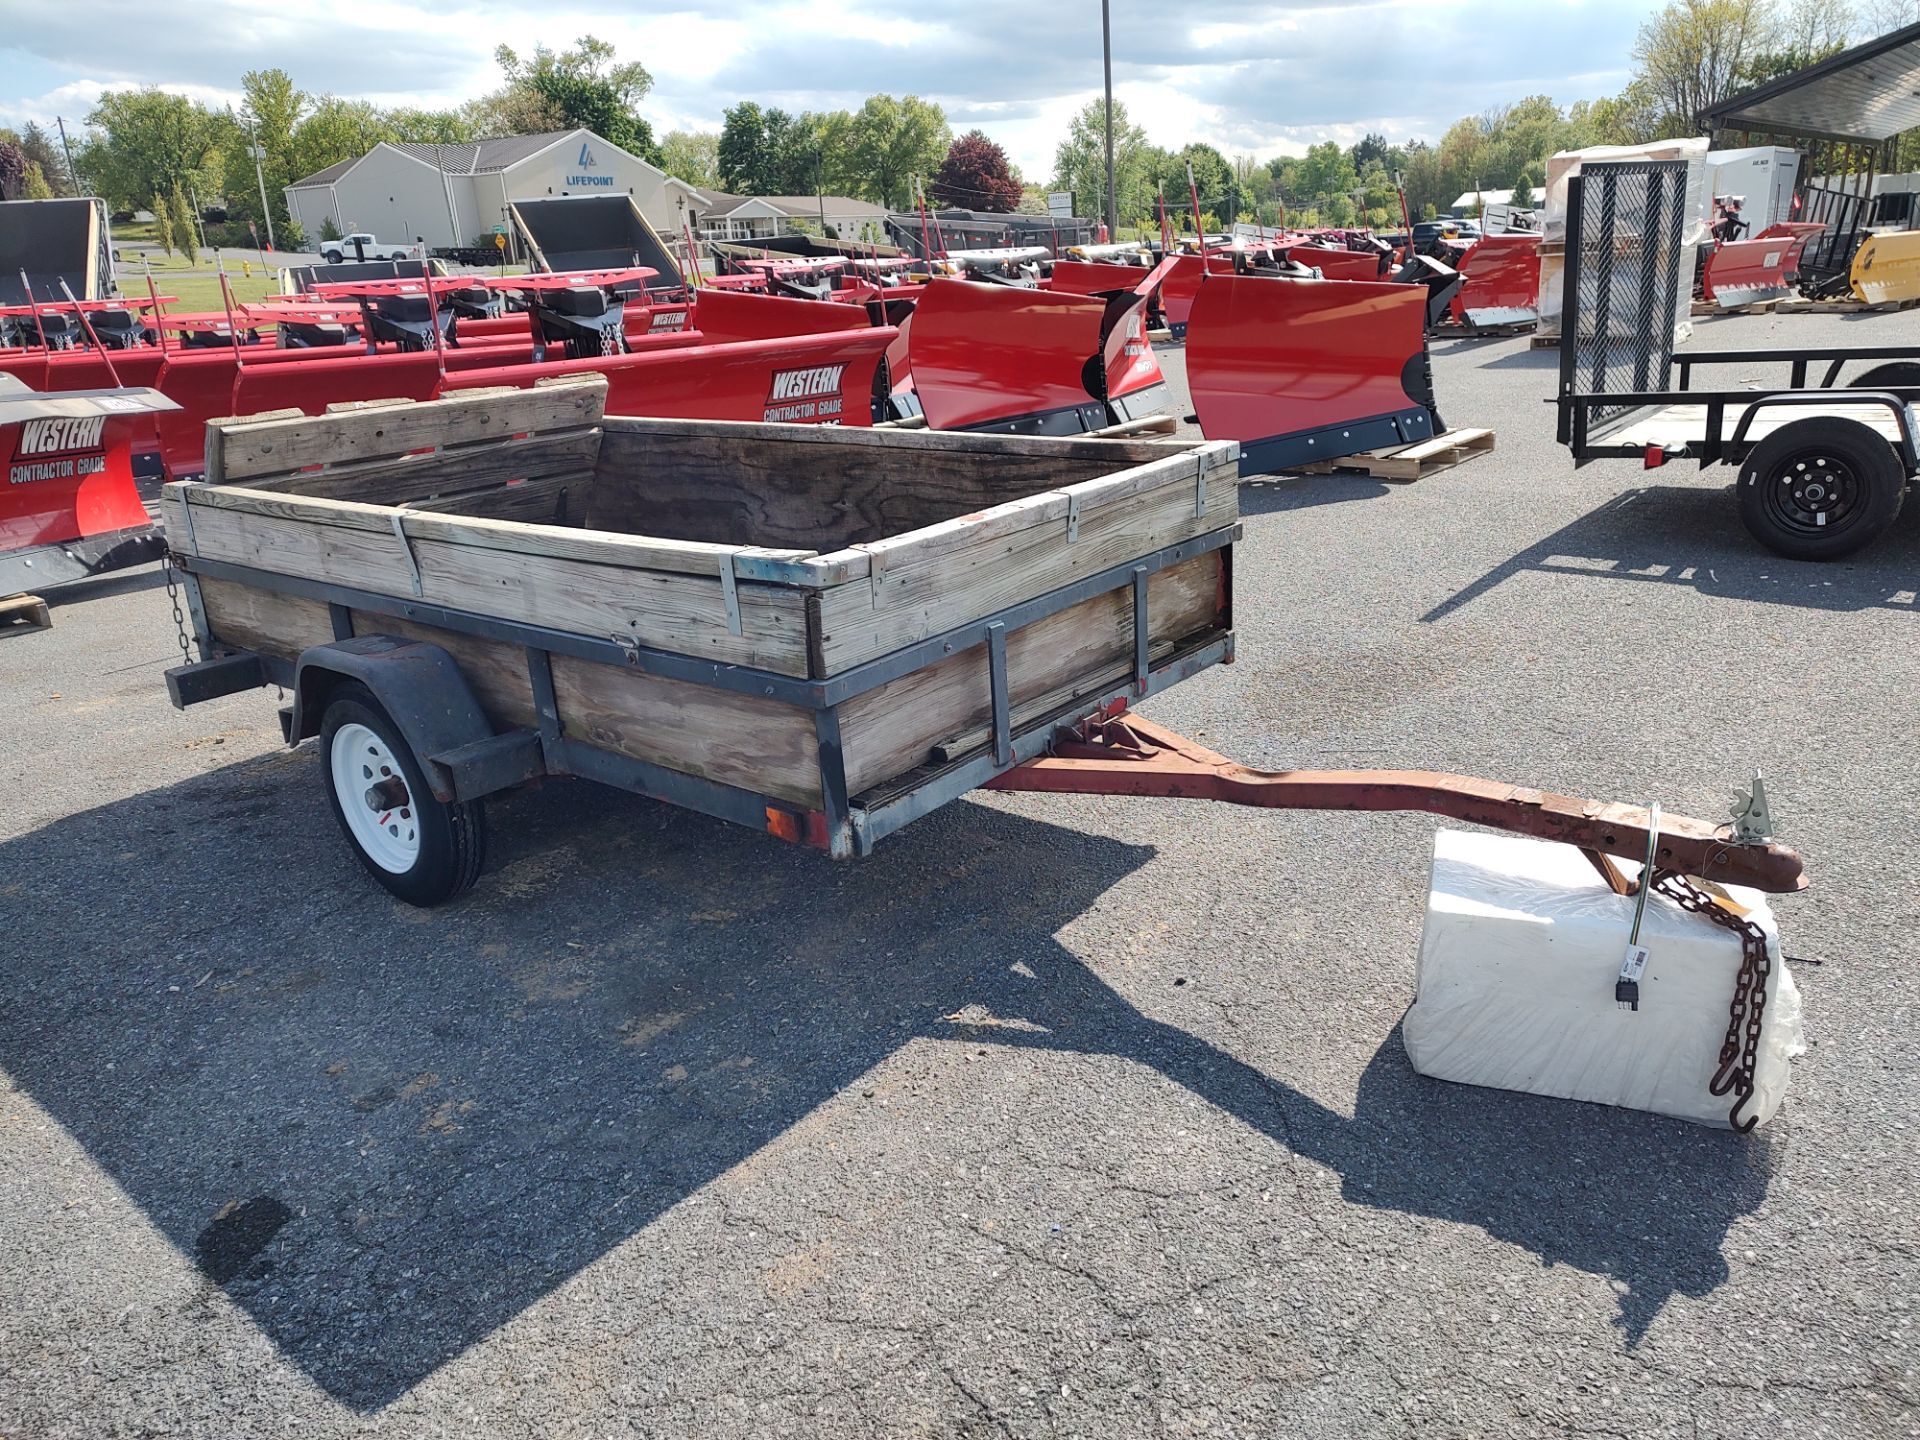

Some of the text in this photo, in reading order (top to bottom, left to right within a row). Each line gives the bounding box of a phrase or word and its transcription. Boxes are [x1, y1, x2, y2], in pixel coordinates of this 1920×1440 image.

[566, 176, 614, 186] LIFEPOINT
[653, 312, 687, 326] WESTERN
[772, 365, 843, 400] WESTERN
[764, 399, 843, 422] CONTRACTOR GRADE
[21, 416, 106, 454] WESTERN
[10, 456, 105, 484] CONTRACTOR GRADE
